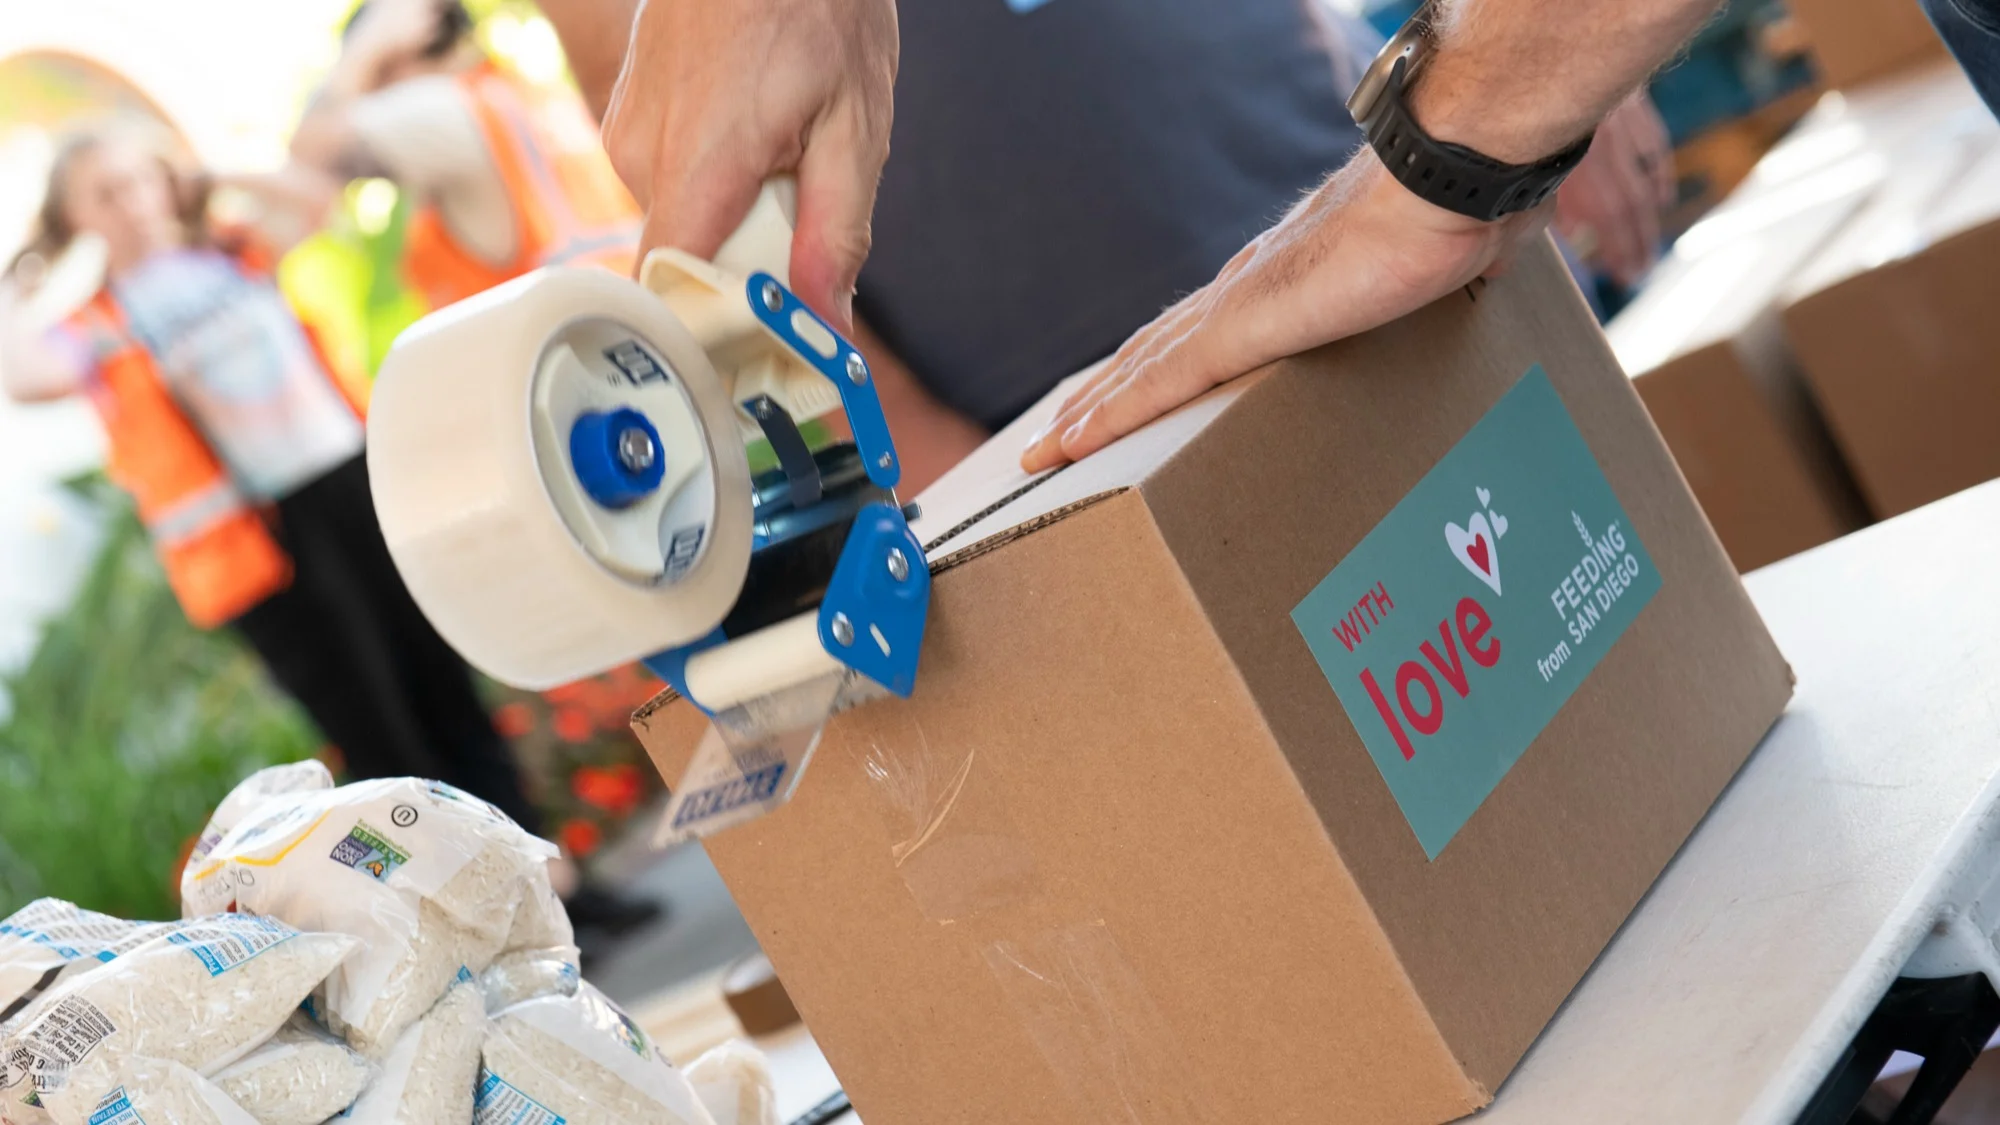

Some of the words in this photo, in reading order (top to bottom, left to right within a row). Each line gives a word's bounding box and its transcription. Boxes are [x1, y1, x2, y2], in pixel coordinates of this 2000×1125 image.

[1332, 582, 1395, 653] WITH
[1537, 639, 1571, 682] from
[1568, 607, 1601, 646] SAN
[1600, 553, 1639, 614] DIEGO
[1358, 597, 1501, 761] love
[332, 849, 355, 865] NON
[339, 842, 363, 858] GMO
